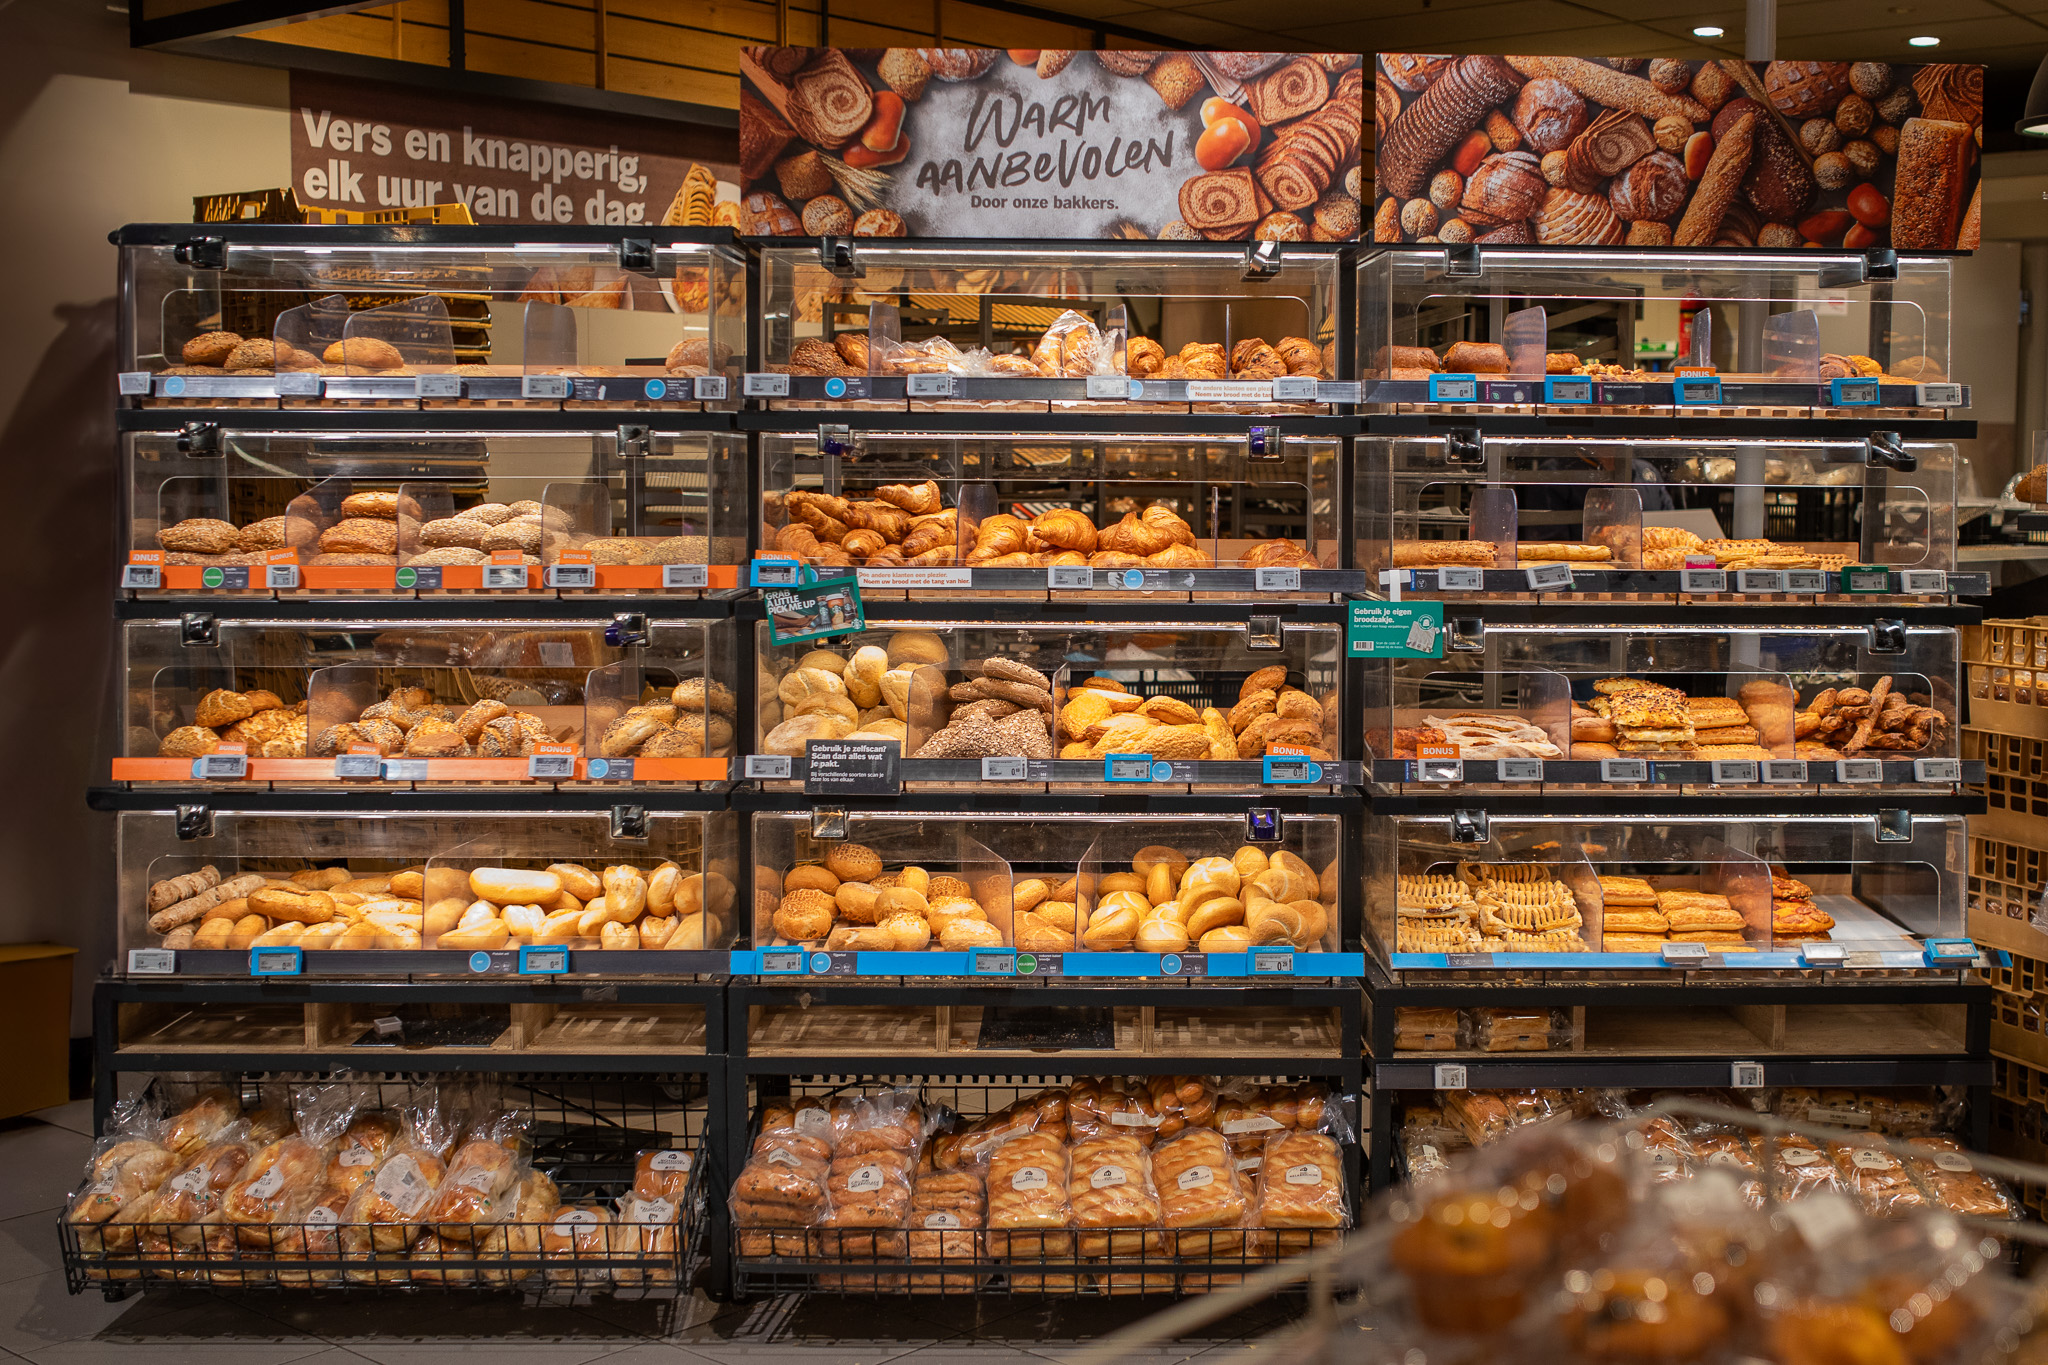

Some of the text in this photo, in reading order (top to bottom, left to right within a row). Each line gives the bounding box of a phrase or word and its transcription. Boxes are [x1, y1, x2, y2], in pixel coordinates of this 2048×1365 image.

[964, 91, 1110, 152] WARM
[301, 107, 648, 194] Vers en knapperig,
[303, 158, 654, 226] elk uur van de dag.
[970, 195, 1119, 210] Door onze bakkers.
[1680, 370, 1710, 378] BONUS
[270, 551, 294, 561] BONUS
[765, 589, 791, 601] GRAB
[767, 594, 800, 608] A LITTLE
[768, 599, 816, 615] PICK ME UP
[1383, 608, 1391, 617] je
[1392, 608, 1412, 617] eigen
[1353, 616, 1395, 624] broodzakje.
[540, 745, 572, 753] BONUS
[843, 745, 851, 754] je
[852, 745, 887, 753] zelfscan?
[1273, 746, 1304, 756] BONUS
[1422, 747, 1454, 755] BONUS
[810, 761, 840, 769] je pakt.
